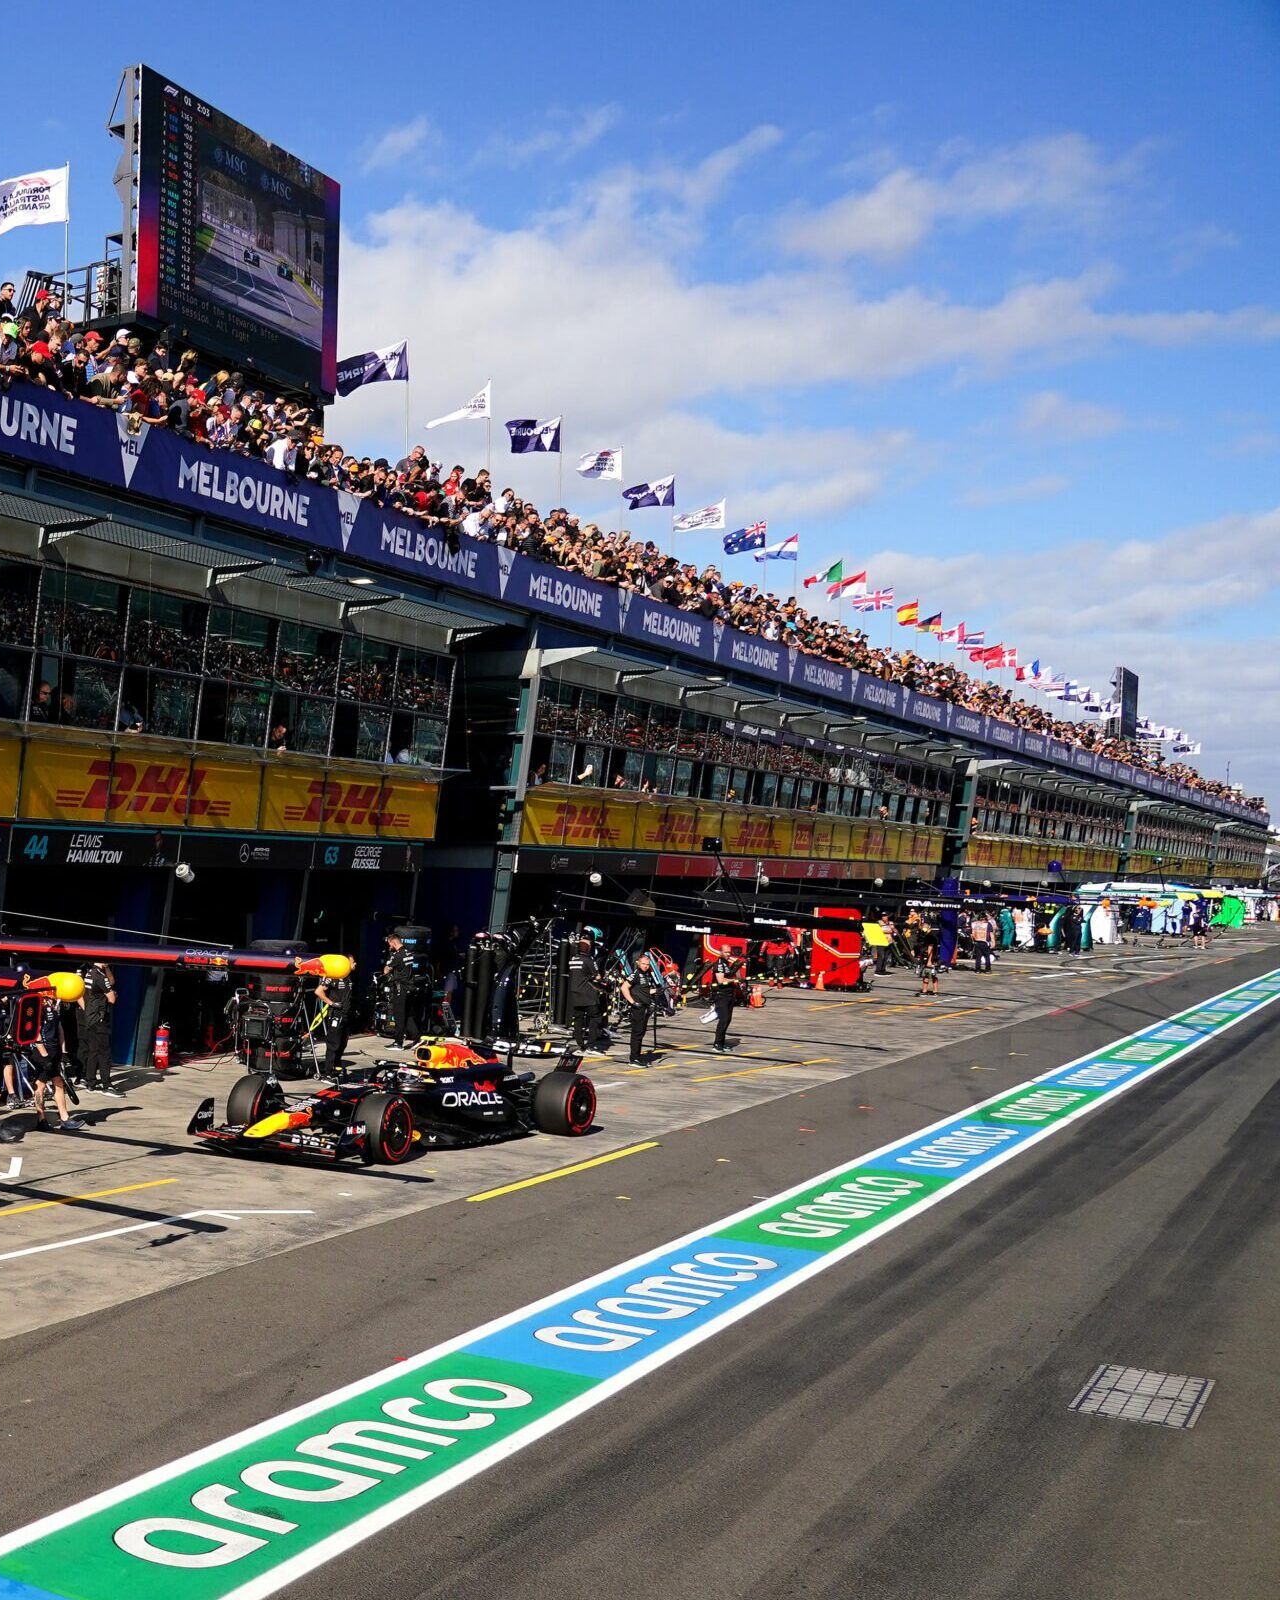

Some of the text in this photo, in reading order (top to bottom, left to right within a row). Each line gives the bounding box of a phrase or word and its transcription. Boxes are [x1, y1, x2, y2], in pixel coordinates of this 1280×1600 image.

[183, 95, 211, 118] Q1 2:03
[225, 150, 248, 175] MSC
[271, 177, 293, 200] MSC
[120, 438, 141, 457] MEL
[178, 455, 310, 527] MELBOURNE
[339, 508, 355, 525] MEL
[381, 522, 477, 579] MELBOURNE
[528, 572, 603, 618] MELBOURNE
[643, 610, 701, 647] MELBOURNE
[732, 640, 779, 671] MELBOURNE
[803, 663, 844, 691] MELBOURNE
[81, 759, 213, 817] DHL
[301, 780, 394, 826] DHL
[552, 803, 613, 840] DHL
[654, 814, 703, 843] DHL
[736, 820, 777, 847] DHL
[24, 834, 48, 860] 44
[70, 834, 103, 848] LEWIS
[354, 845, 383, 857] GEORGE
[66, 849, 123, 864] HAMILTON
[324, 846, 340, 865] 63
[351, 858, 381, 870] RUSSELL
[186, 949, 230, 957] ORACLE
[442, 1091, 504, 1107] ORACLE
[990, 1089, 1087, 1121] aramco
[197, 1110, 214, 1119] Claro
[346, 1125, 366, 1135] Mobil
[896, 1125, 1019, 1168] aramco
[758, 1175, 924, 1238] aramco
[533, 1251, 778, 1352] aramco
[112, 1378, 533, 1569] aramco
